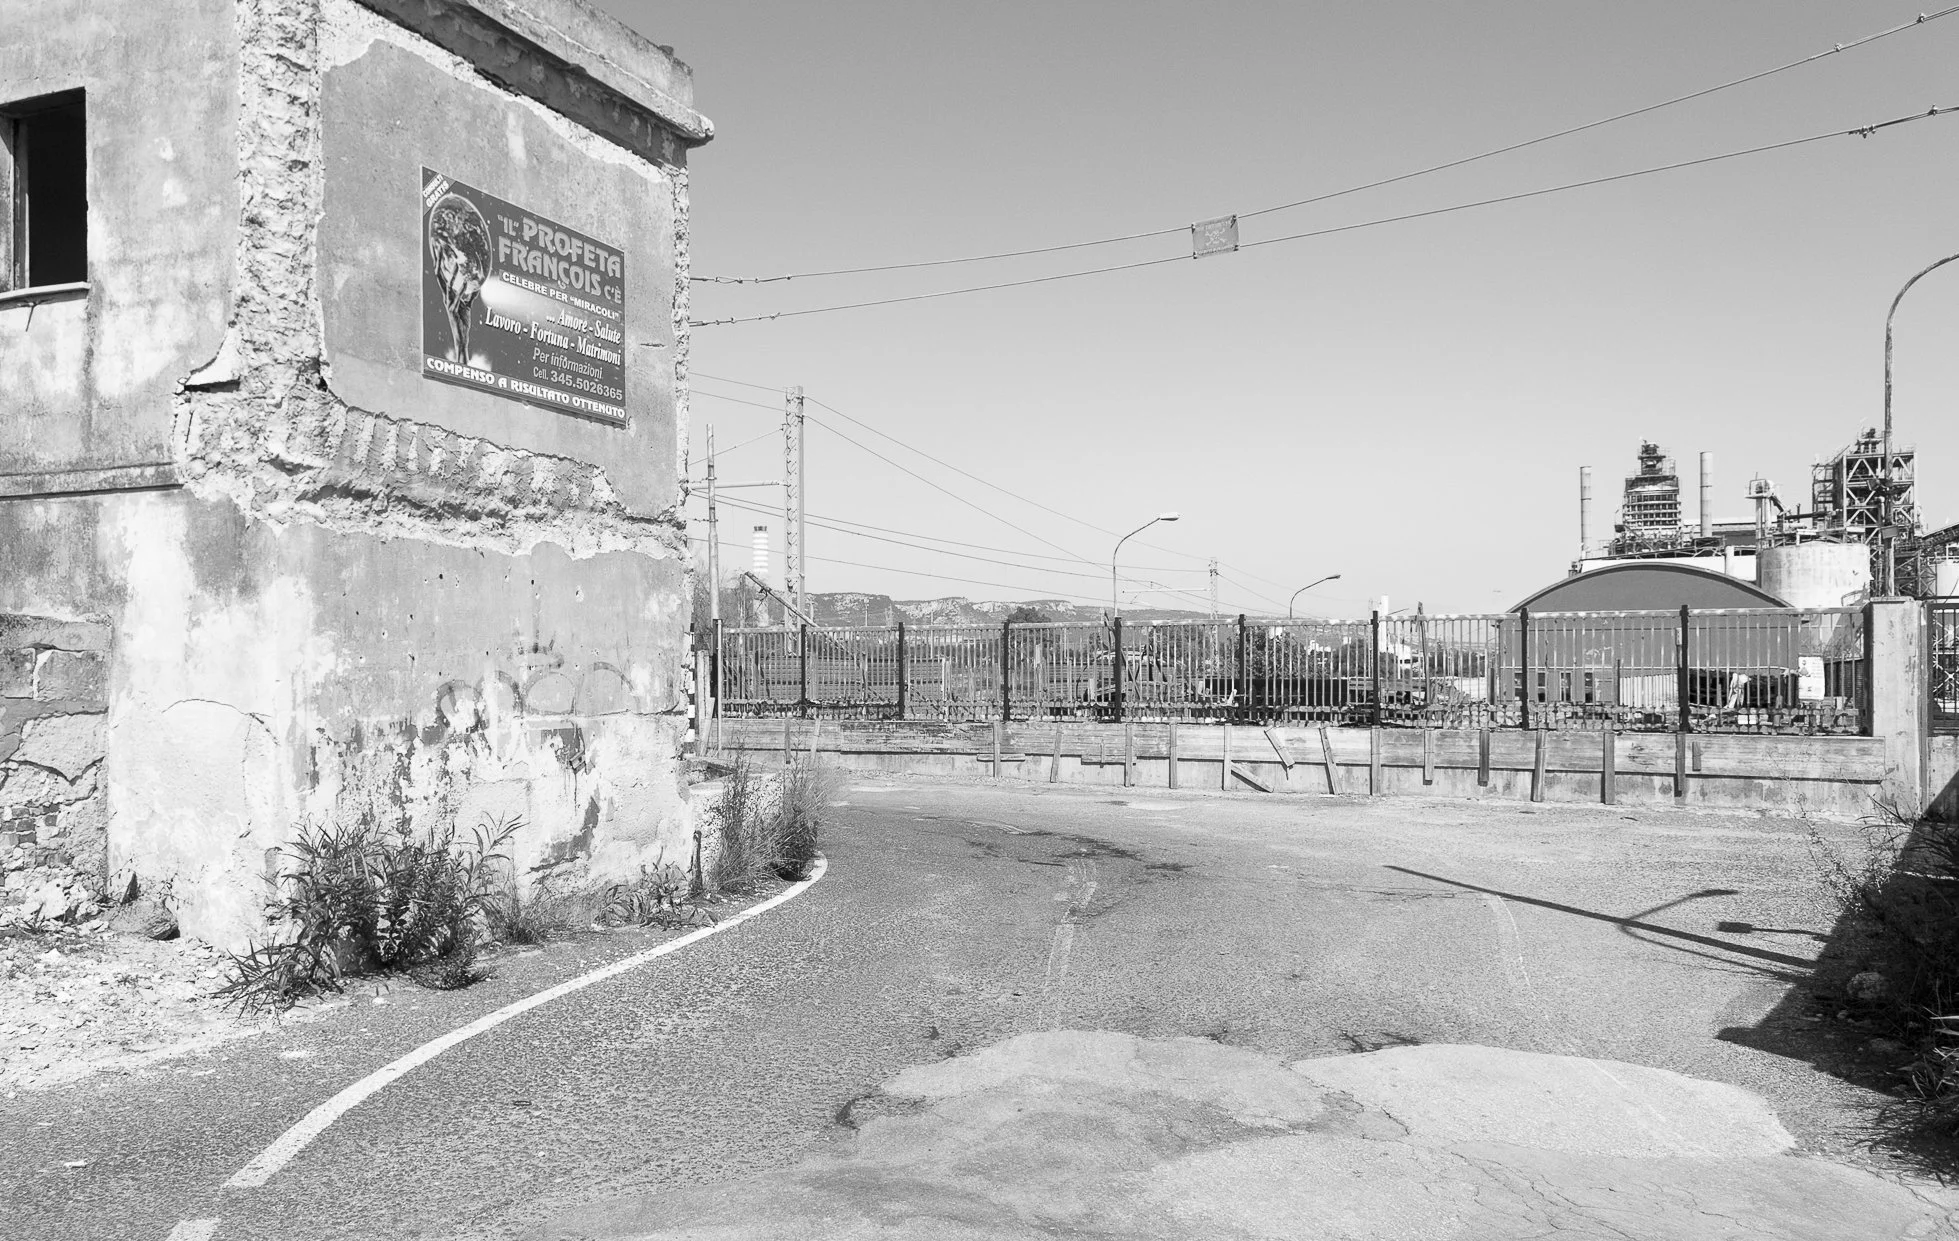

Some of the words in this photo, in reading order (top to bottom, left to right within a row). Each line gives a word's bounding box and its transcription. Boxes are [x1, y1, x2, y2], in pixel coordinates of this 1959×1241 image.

[426, 180, 450, 207] GRATIS
[522, 217, 621, 278] PROFETA
[502, 271, 548, 295] CELEBRE
[550, 288, 568, 302] PER
[570, 296, 619, 319] "MIRACOLI"
[603, 285, 622, 304] C'È
[485, 306, 522, 335] Lavoro
[530, 321, 569, 350] Fortuna
[576, 336, 621, 366] Matrimoni
[557, 308, 588, 333] Amore
[594, 319, 621, 344] Salute
[533, 347, 550, 363] Per
[550, 352, 603, 379] informazioni
[426, 357, 495, 385] COMPENSO
[498, 377, 508, 388] A
[510, 380, 570, 404] RISULTATO
[572, 396, 626, 418] OTTENUTO
[533, 366, 549, 380] Cell.
[550, 370, 623, 400] 345.5026365
